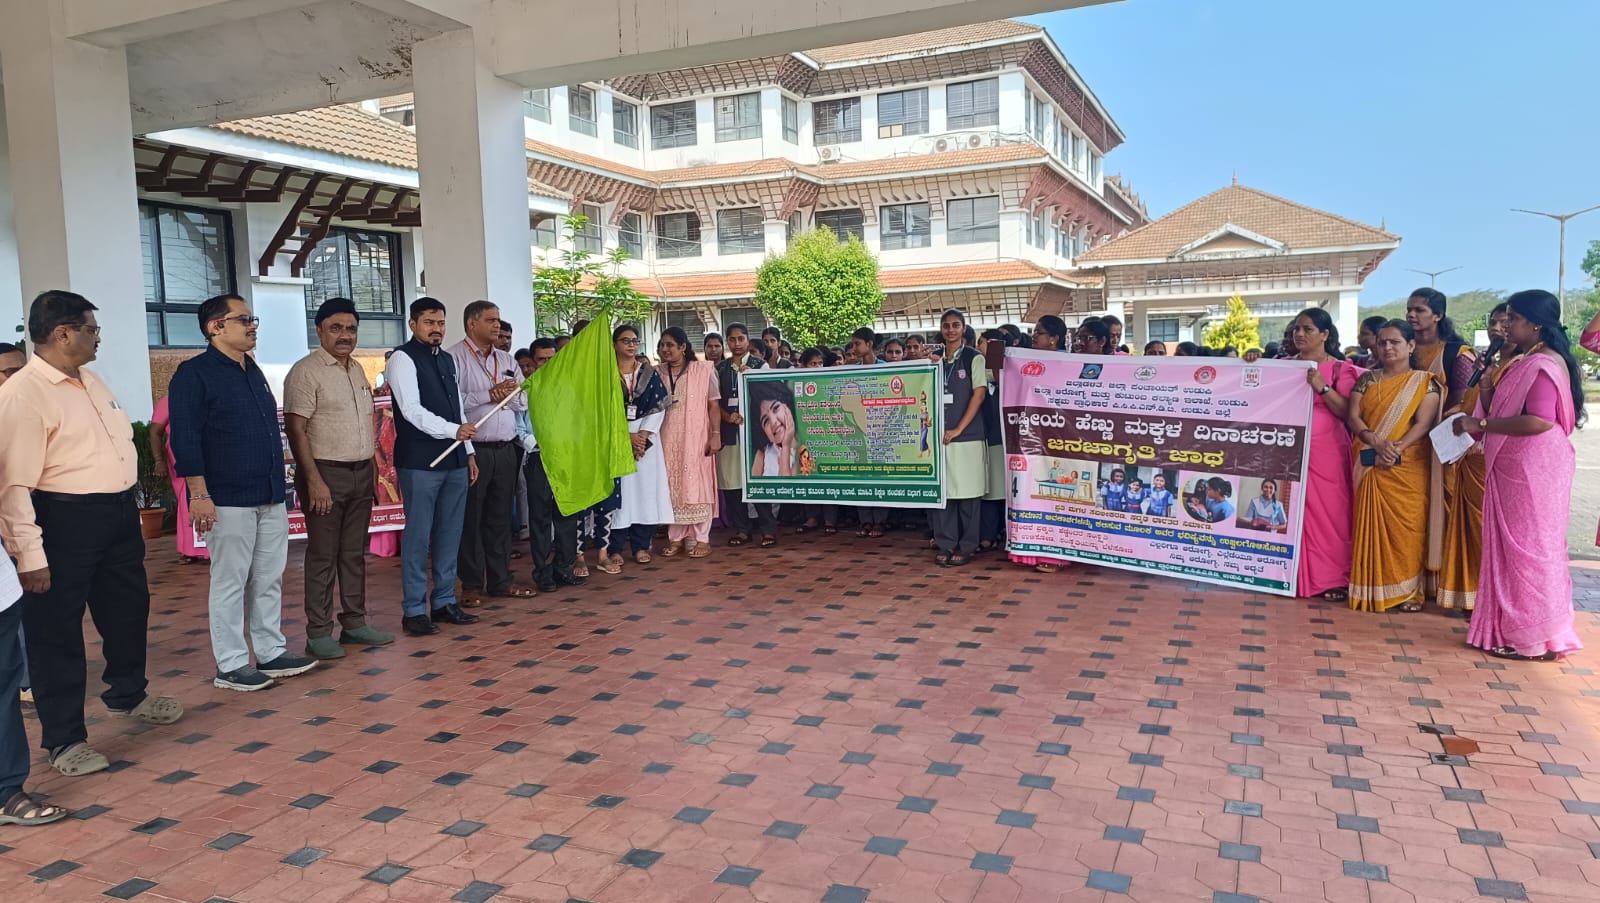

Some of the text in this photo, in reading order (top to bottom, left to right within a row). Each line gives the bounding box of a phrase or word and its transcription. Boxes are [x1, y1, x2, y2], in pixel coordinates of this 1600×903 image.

[1109, 382, 1126, 390] ಜಿಲ್ಲಾ
[1131, 383, 1178, 391] ಪಂಚಾಯತ್
[1056, 389, 1086, 399] ಆರೋಗ್ಯ
[1092, 392, 1110, 400] ಮತ್ತು
[1152, 396, 1179, 405] ಕಲ್ಯಾಣ
[1218, 399, 1248, 407] ಉಡುಪಿ
[1048, 398, 1069, 406] ಸಕ್ಷಮ
[1074, 399, 1108, 408] ಪ್ರಾಧಿಕಾರ
[1216, 408, 1231, 417] ಜಿಲ್ಲೆ
[1007, 412, 1295, 447] ರಾಷ್ಟ್ರೀಯ ಹೆಣ್ಣು ಮಕ್ಕಳ ದಿನಾಚರಣೆ
[1048, 438, 1224, 467] ಜನಜಾಗೃತಿ ಜಾಥ
[777, 487, 794, 498] ಆರೋಗ್ಯ
[796, 488, 807, 496] ಮತ್ತು
[826, 488, 840, 499] ಕಲ್ಯಾಣ
[907, 489, 921, 498] ವಿಭಾಗ
[373, 514, 387, 522] ವಿಭಾಗ
[1124, 526, 1152, 534] ಮೂಲಕ
[1178, 532, 1216, 546] ಭವಿಷ್ಯವನ್ನು
[1169, 553, 1185, 563] ನಿಮ್ಮ
[1223, 562, 1239, 572] ನಮ್ಮ
[1244, 564, 1264, 575] ಆದ್ಯತೆ
[1257, 557, 1287, 569] ಆರೋಗ್ಯ
